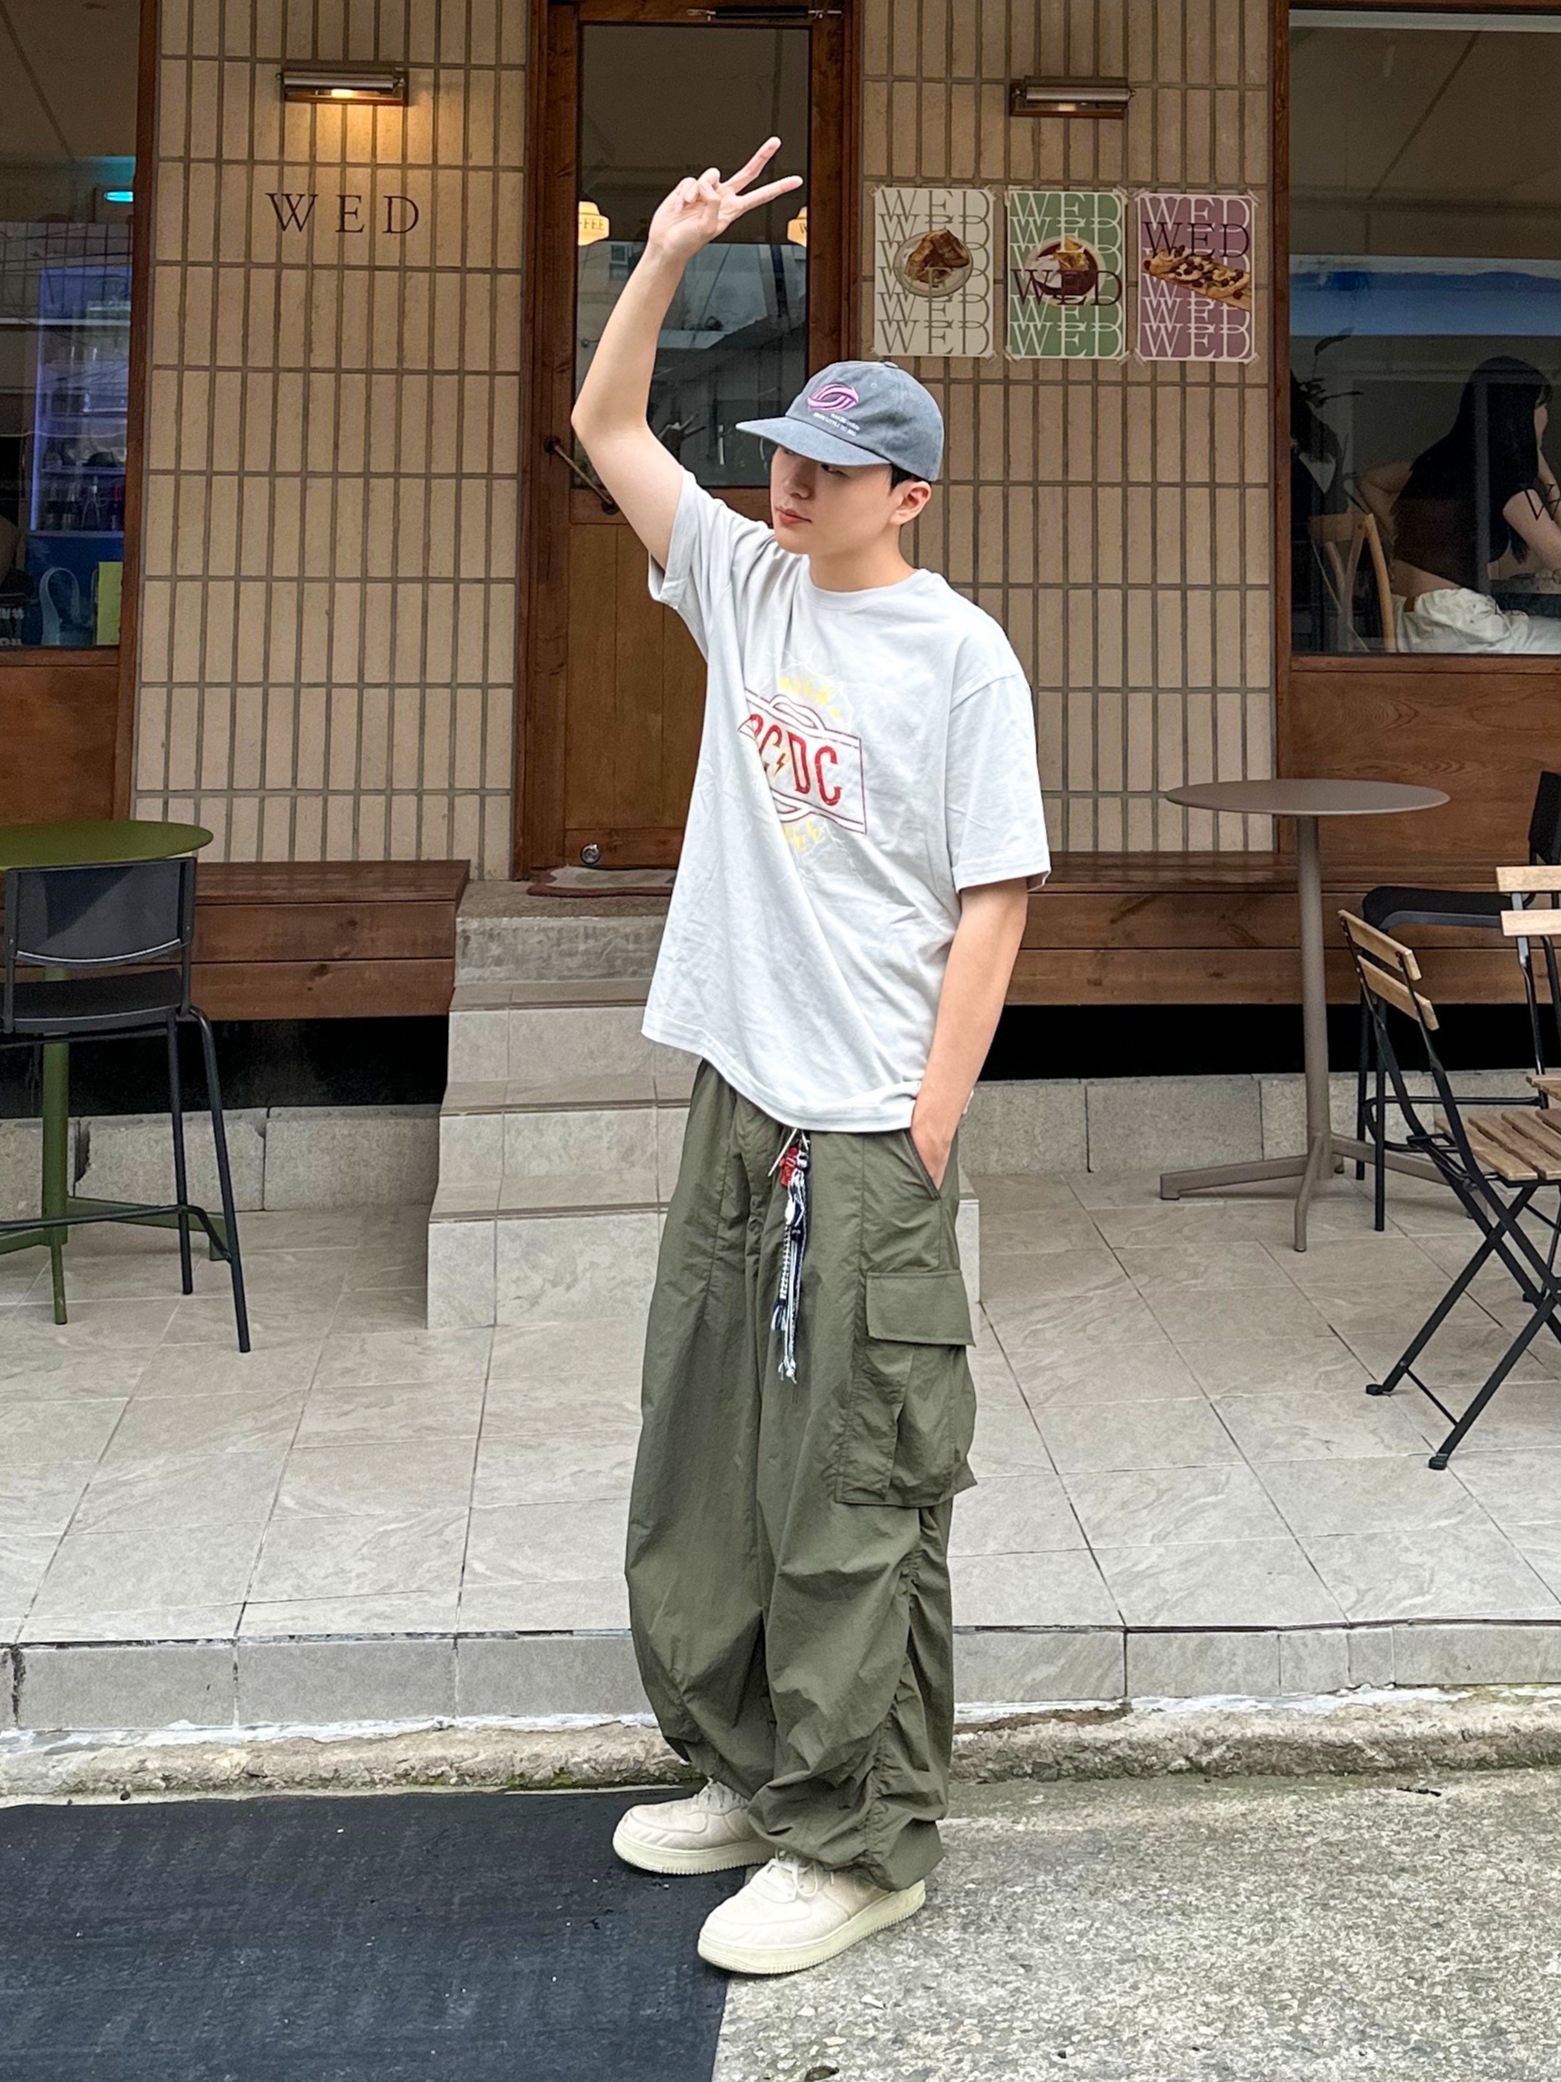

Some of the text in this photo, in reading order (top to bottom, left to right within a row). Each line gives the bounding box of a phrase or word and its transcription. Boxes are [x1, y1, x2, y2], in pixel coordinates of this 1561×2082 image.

[265, 193, 419, 234] WED
[579, 217, 605, 231] FEE
[880, 190, 990, 224] WED
[1012, 192, 1122, 227] WED
[1143, 197, 1250, 232] WED
[1142, 221, 1250, 258] WED
[1010, 269, 1123, 306] WED
[877, 292, 990, 329] WED
[877, 320, 990, 355] WED
[1010, 322, 1122, 357] WED
[1142, 323, 1250, 359] WED
